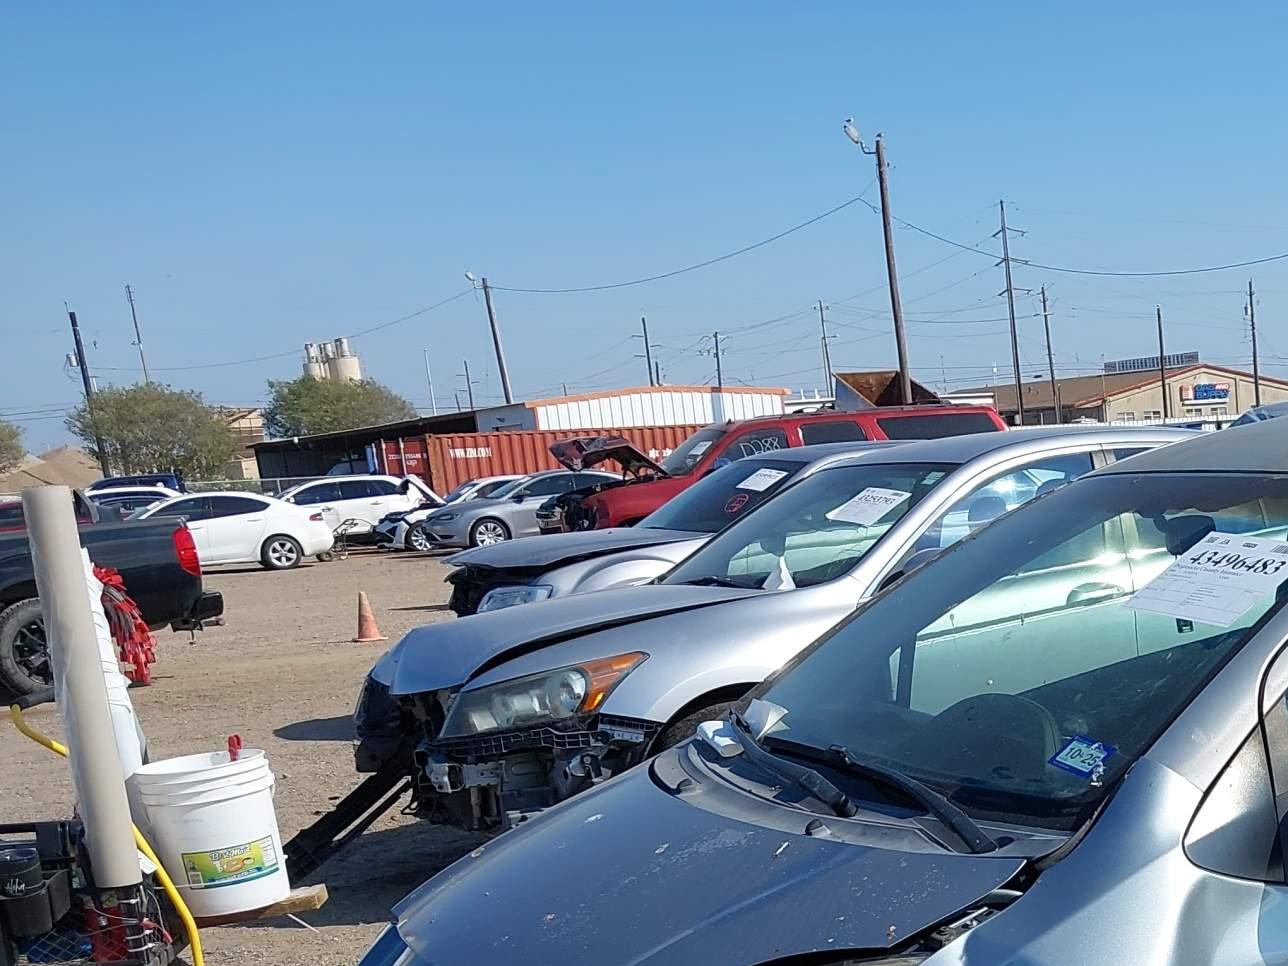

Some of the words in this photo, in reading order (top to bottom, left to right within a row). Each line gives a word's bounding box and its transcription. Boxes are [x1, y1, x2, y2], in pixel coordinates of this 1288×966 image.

[1190, 550, 1288, 576] 43496483
[1065, 747, 1082, 760] 10
[1080, 753, 1101, 767] 25
